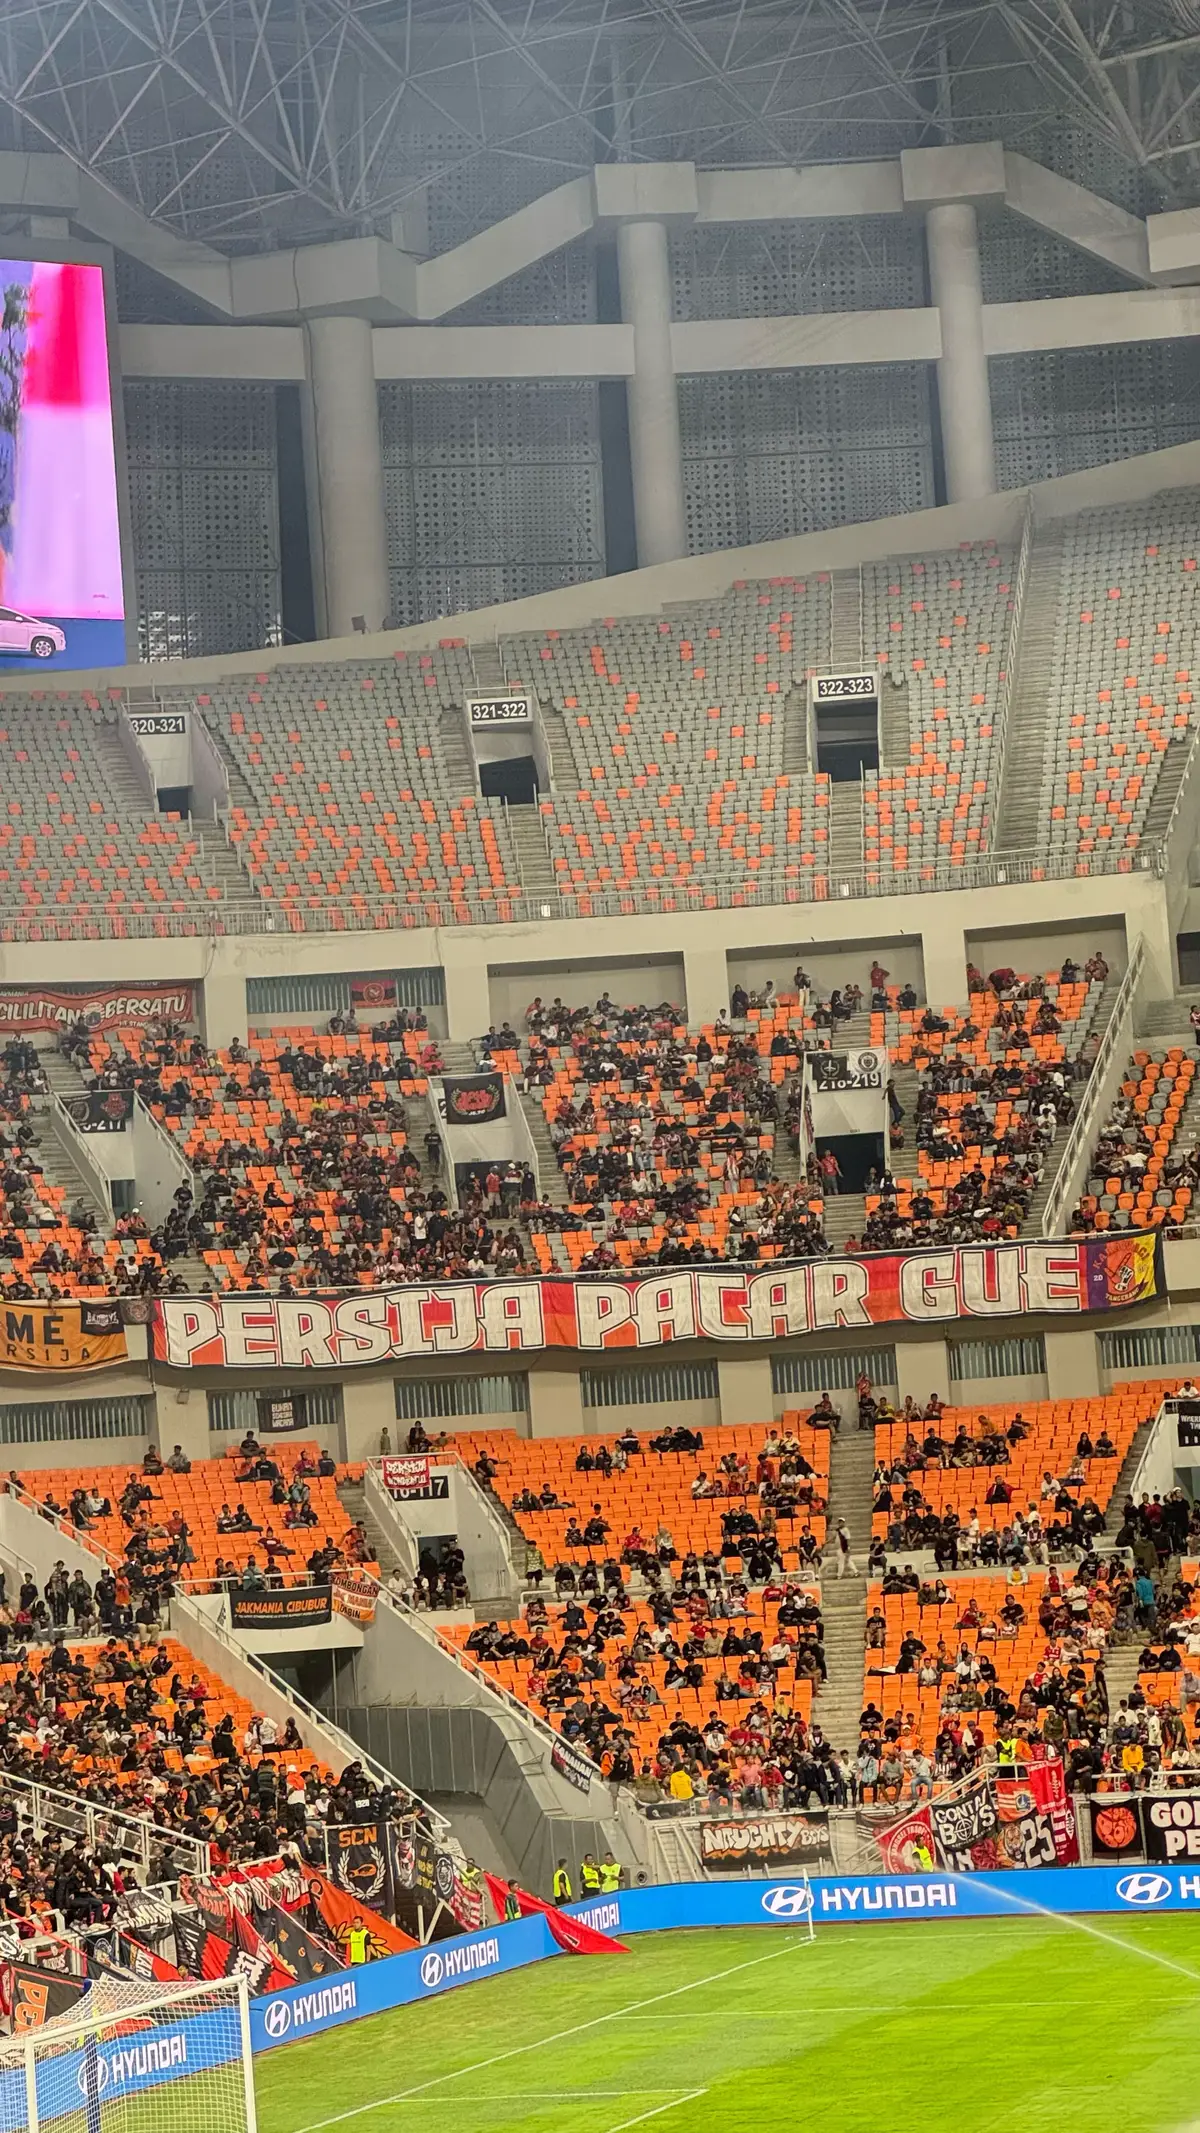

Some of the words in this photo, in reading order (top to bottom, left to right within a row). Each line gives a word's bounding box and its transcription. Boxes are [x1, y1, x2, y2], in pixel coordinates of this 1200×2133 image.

[820, 678, 873, 695] 322-323
[473, 703, 526, 719] 321-322
[132, 718, 183, 733] 320-321
[105, 994, 187, 1018] BERSATU
[162, 1282, 546, 1367] PERSIJA
[573, 1260, 872, 1350] PACAR
[900, 1244, 1081, 1321] GUE
[235, 1602, 283, 1614] JAKMANIA
[286, 1597, 327, 1612] CIBUBUR
[339, 1826, 377, 1848] SCN
[703, 1821, 804, 1853] NAUGHTY
[1020, 1815, 1056, 1868] 25
[822, 1884, 957, 1911] HYUNDAI
[573, 1903, 619, 1931] YUNDAI
[445, 1938, 499, 1977] HYUNDAI
[293, 1981, 356, 2027] HYUNDAI
[112, 2034, 187, 2083] HYUNDAI
